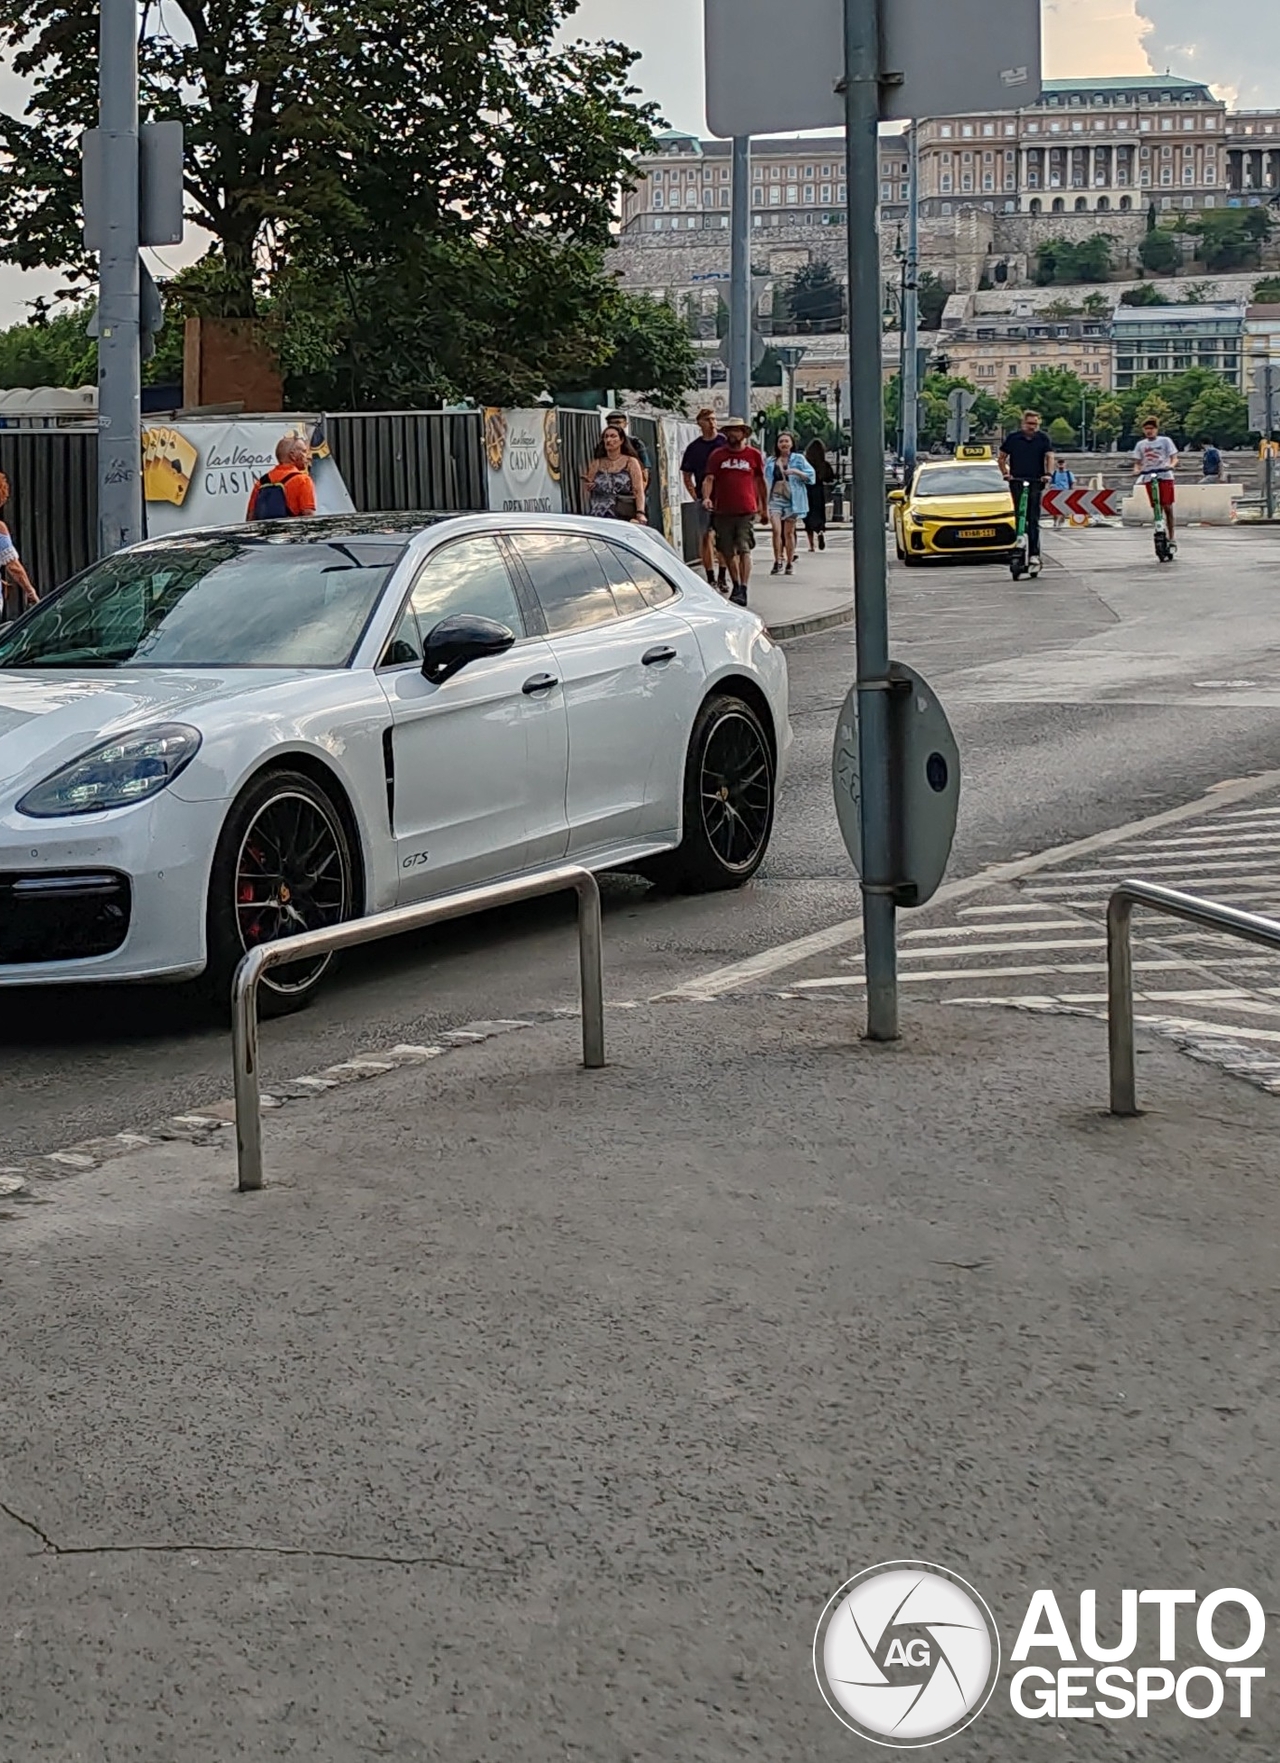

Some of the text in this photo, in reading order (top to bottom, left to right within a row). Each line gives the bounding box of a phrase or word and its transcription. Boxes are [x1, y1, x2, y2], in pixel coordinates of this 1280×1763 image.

[509, 450, 540, 471] CASINO
[965, 447, 984, 455] TAXI
[205, 469, 263, 496] CASIN
[402, 850, 429, 868] GTS
